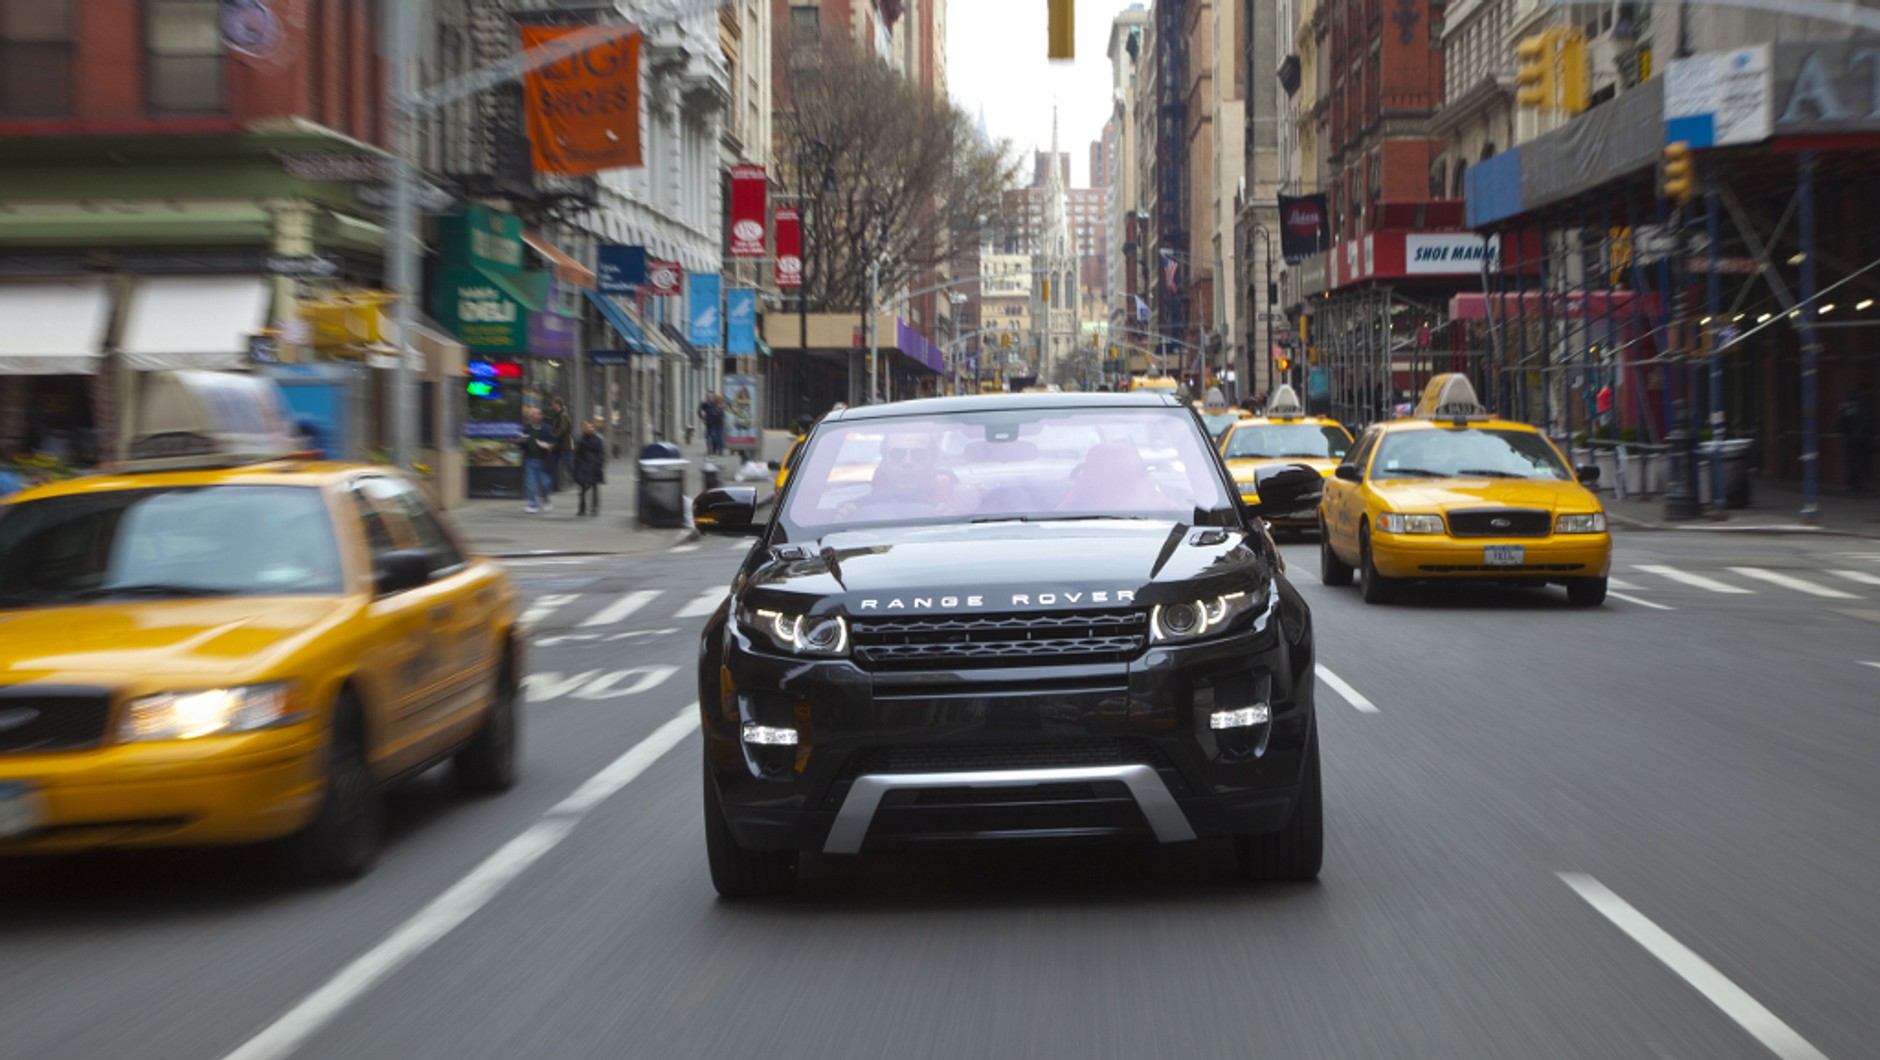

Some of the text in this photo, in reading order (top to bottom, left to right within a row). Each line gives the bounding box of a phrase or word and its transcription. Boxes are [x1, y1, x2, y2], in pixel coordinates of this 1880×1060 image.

[1414, 246, 1450, 261] SHOE
[861, 590, 1135, 610] RANGE ROVER
